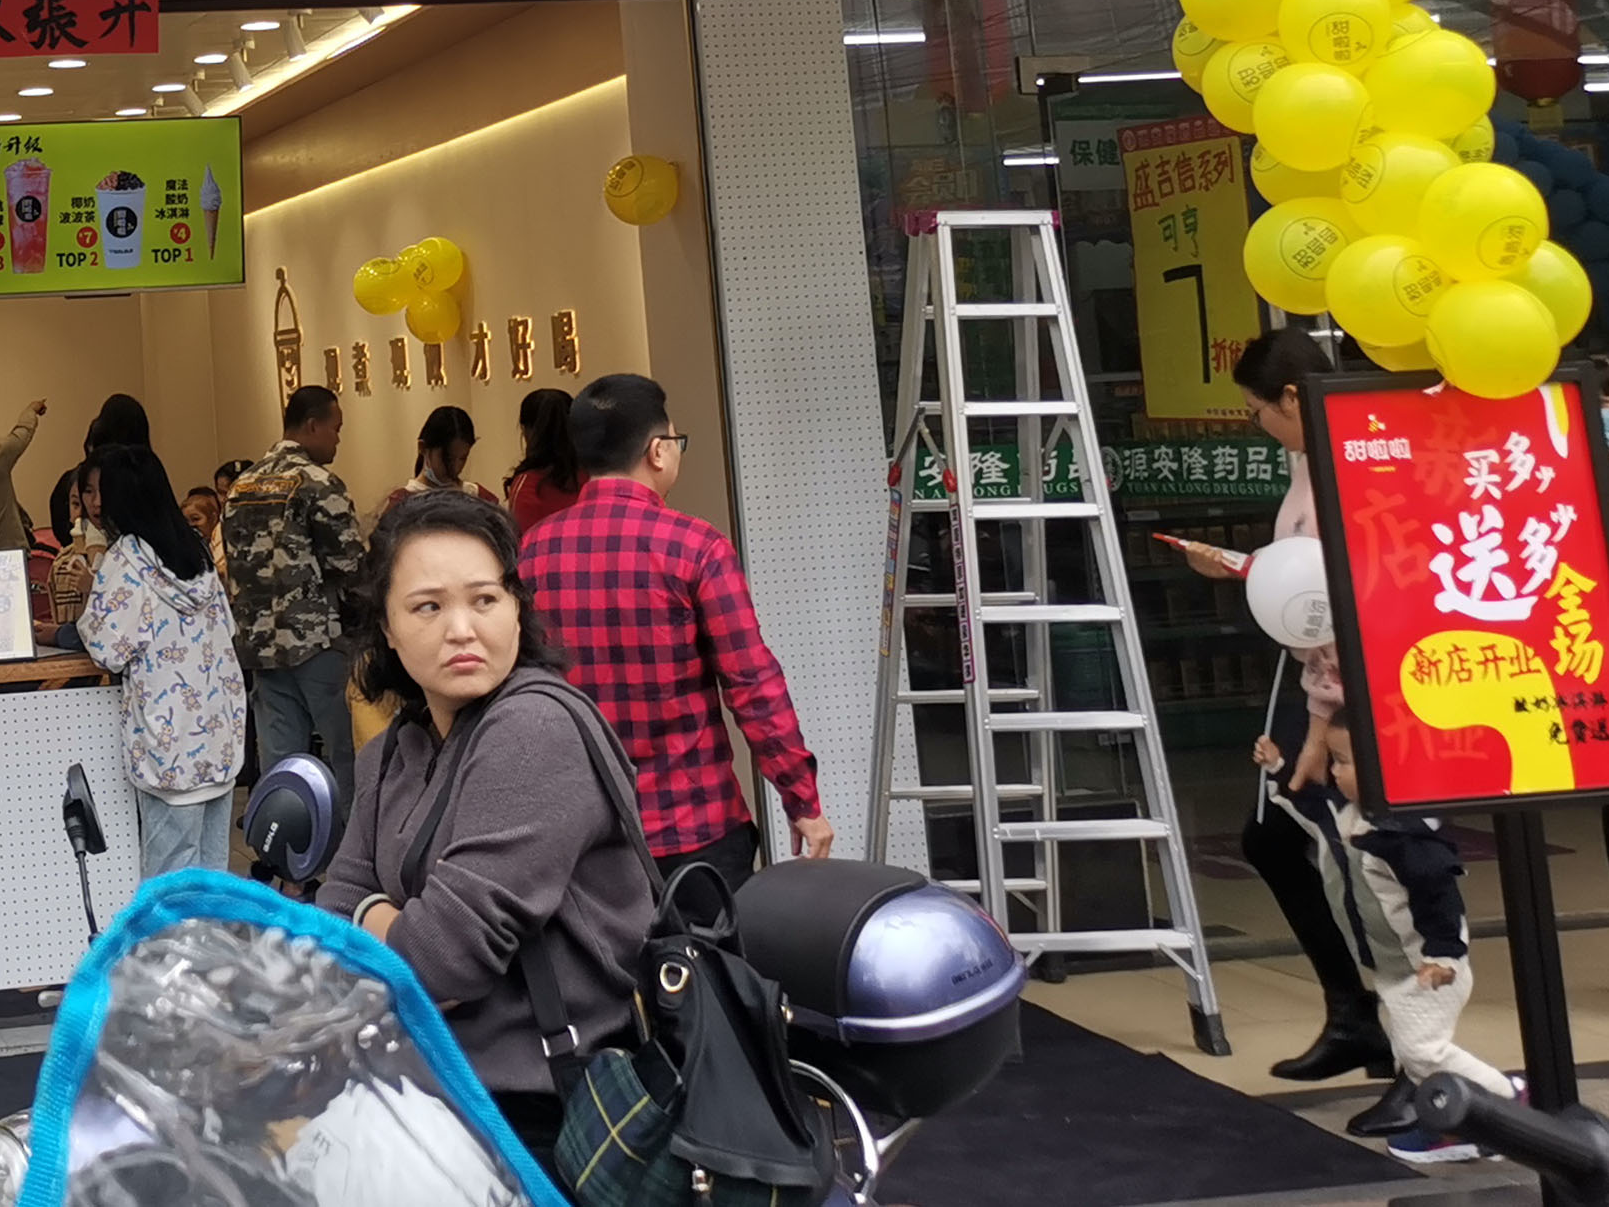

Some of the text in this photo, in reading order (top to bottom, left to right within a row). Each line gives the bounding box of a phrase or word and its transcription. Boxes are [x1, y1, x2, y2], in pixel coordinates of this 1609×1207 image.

[165, 179, 188, 191] 魔法
[71, 197, 95, 209] 椰奶
[165, 194, 188, 206] 酸奶
[59, 211, 95, 224] 波波茶
[155, 208, 189, 219] 冰淇淋
[57, 252, 99, 267] TOP 2
[152, 249, 182, 263] TOP
[185, 248, 193, 263] 1
[1462, 431, 1557, 500] 买多少
[1428, 502, 1578, 622] 送多少
[1544, 561, 1604, 685] 全场
[1408, 643, 1544, 687] 新店开业
